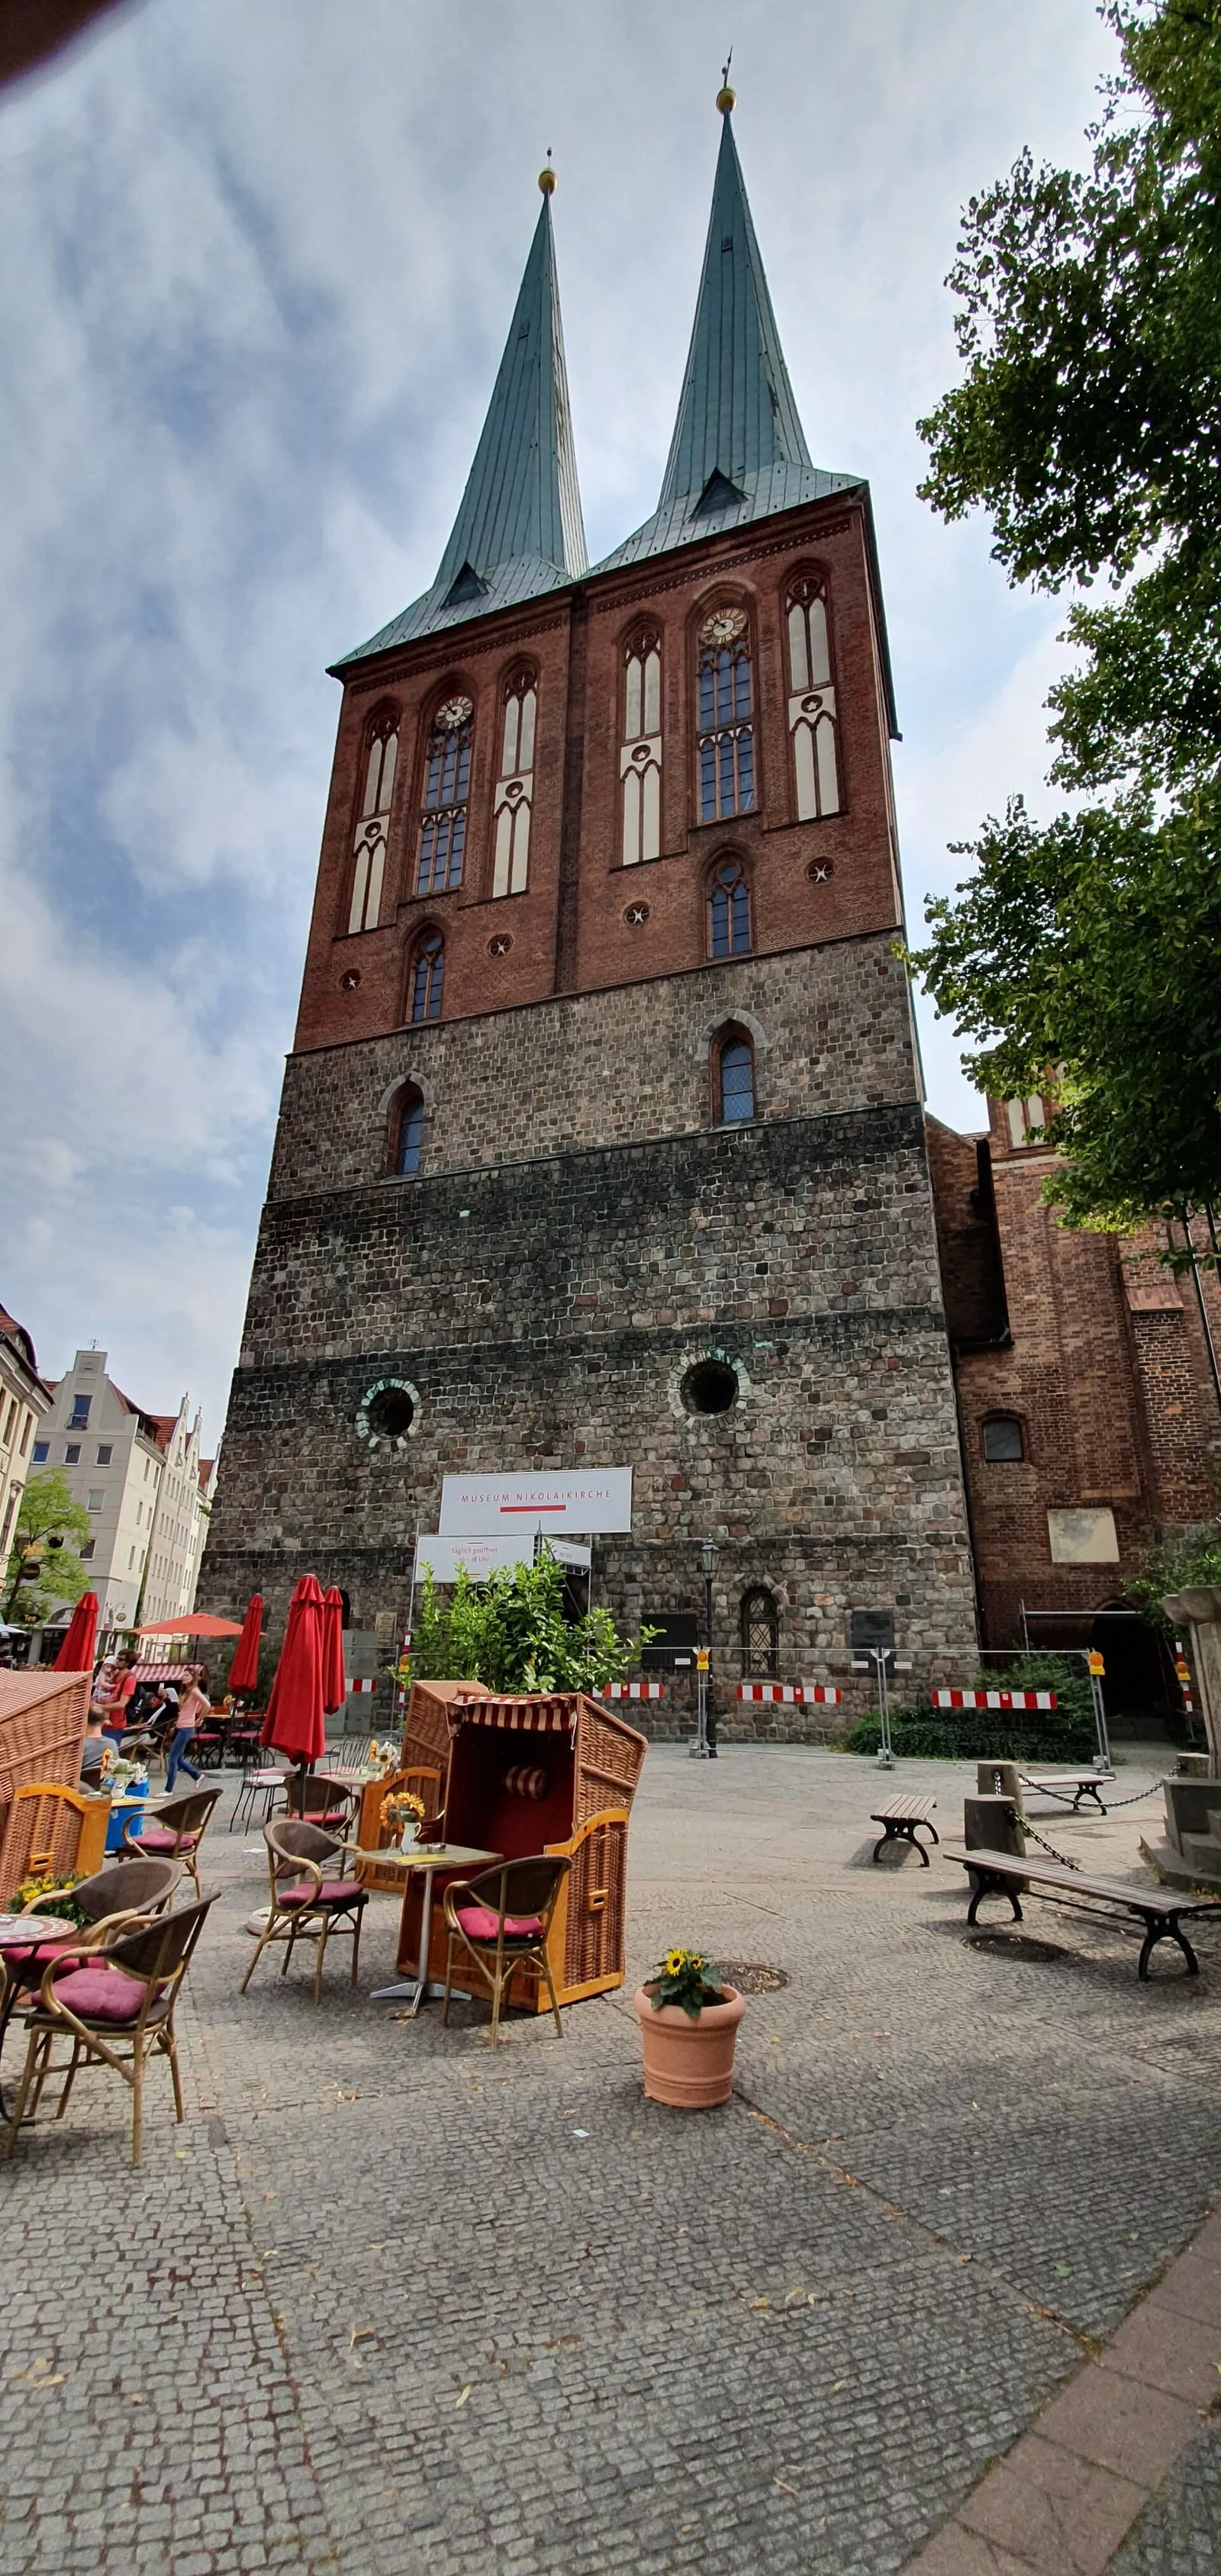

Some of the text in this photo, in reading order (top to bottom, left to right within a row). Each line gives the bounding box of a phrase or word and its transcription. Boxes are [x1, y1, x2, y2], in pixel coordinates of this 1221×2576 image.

[461, 1490, 610, 1502] MUSEUM NIKOLAIKIRCHE
[452, 1546, 498, 1556] täglich geöffnet
[24, 1614, 37, 1622] Tee
